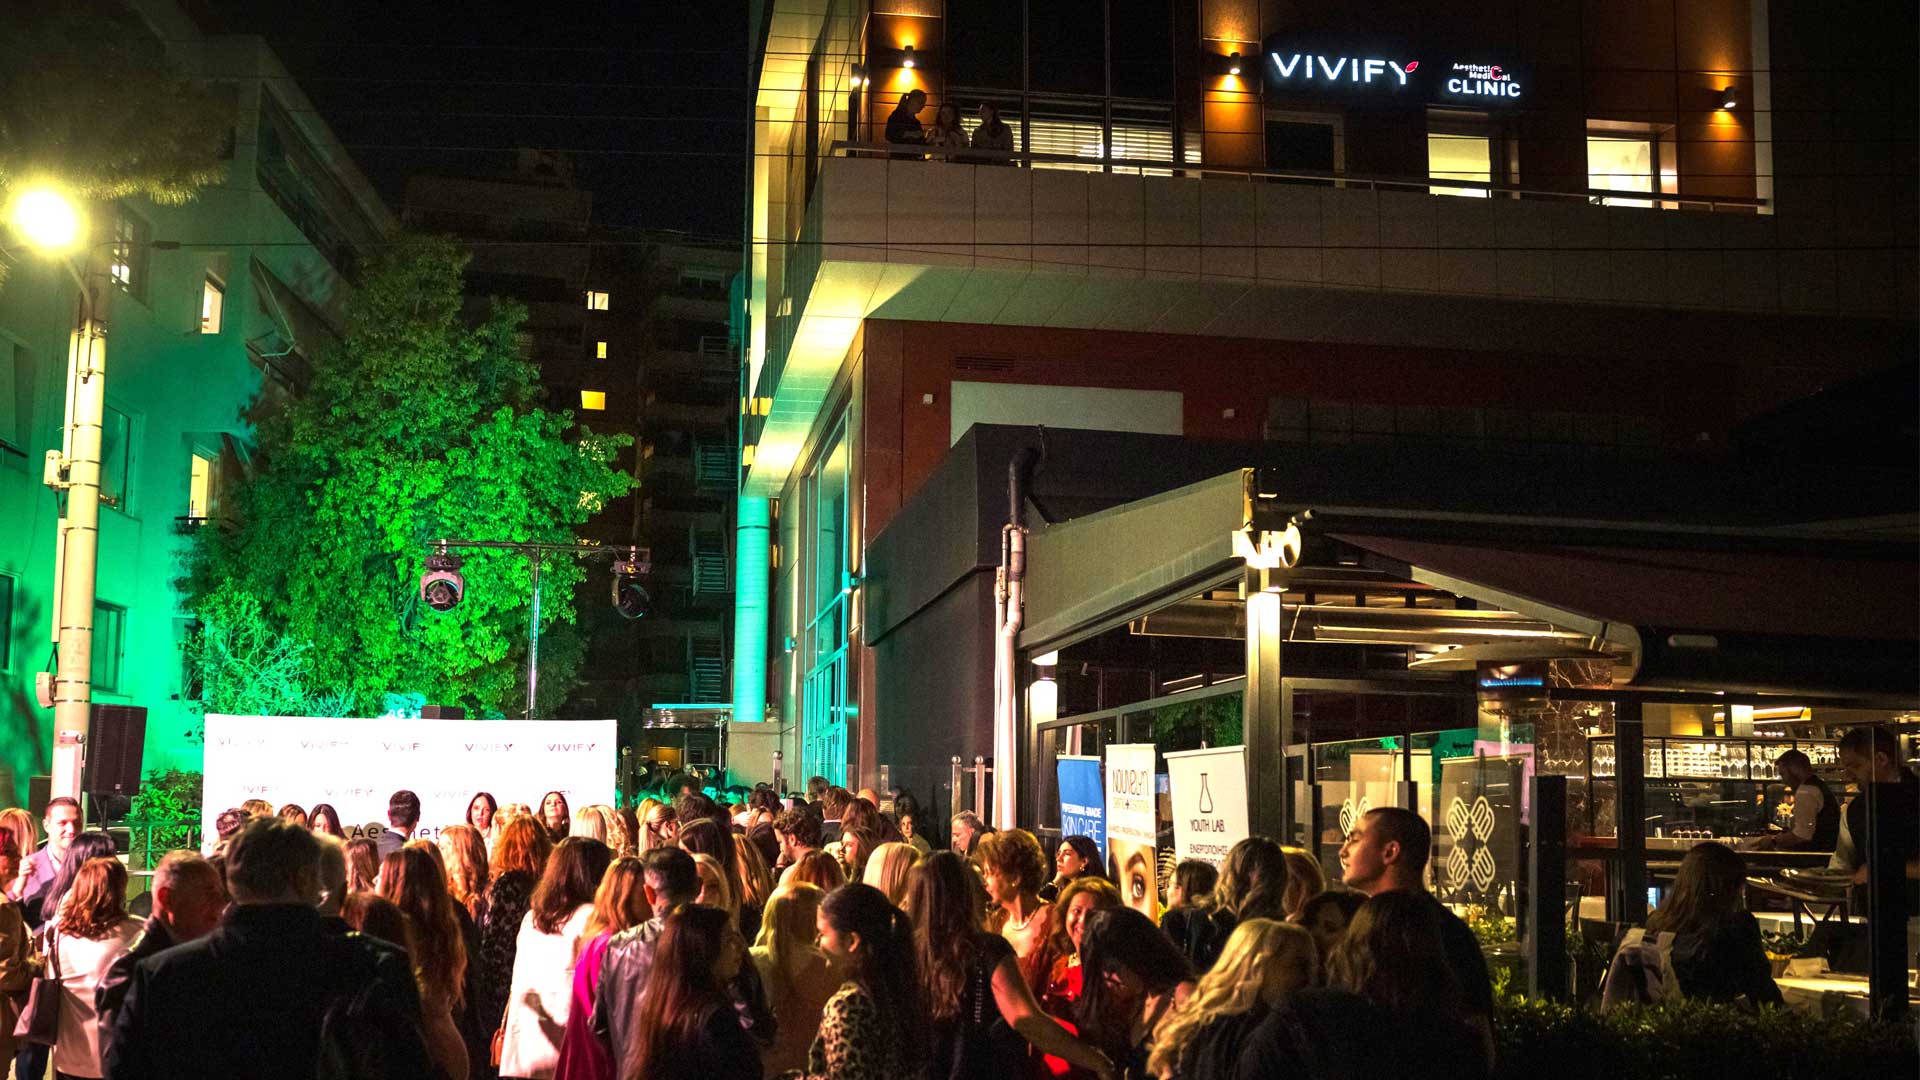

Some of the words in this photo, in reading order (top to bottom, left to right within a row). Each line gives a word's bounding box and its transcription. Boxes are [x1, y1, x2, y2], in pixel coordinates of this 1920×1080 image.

[1272, 52, 1419, 85] VIVIFY
[1448, 78, 1521, 97] CLINIC
[548, 743, 596, 752] VIVIFY
[1190, 819, 1210, 832] YOUTH
